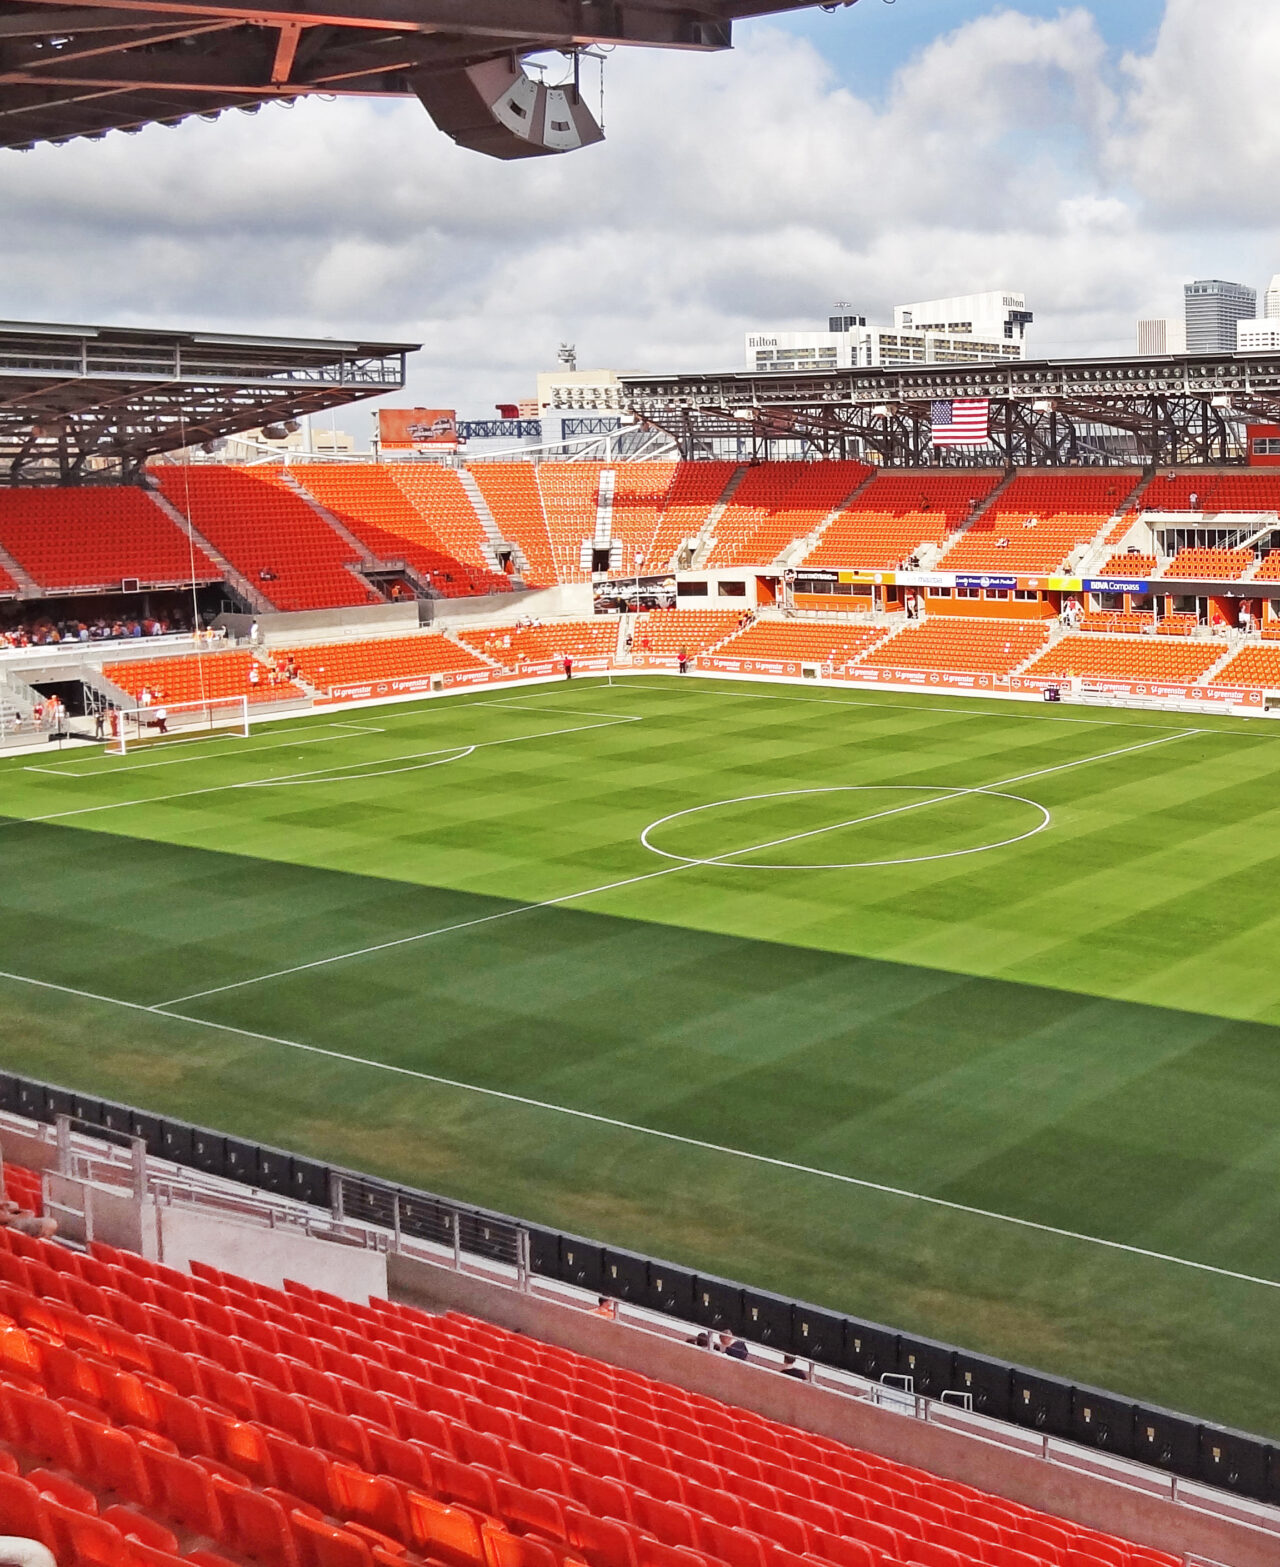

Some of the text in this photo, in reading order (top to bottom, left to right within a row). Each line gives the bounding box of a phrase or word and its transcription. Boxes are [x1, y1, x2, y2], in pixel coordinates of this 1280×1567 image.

[1002, 296, 1024, 308] Hilton
[748, 336, 777, 347] Hilton
[1109, 582, 1140, 591] Compass
